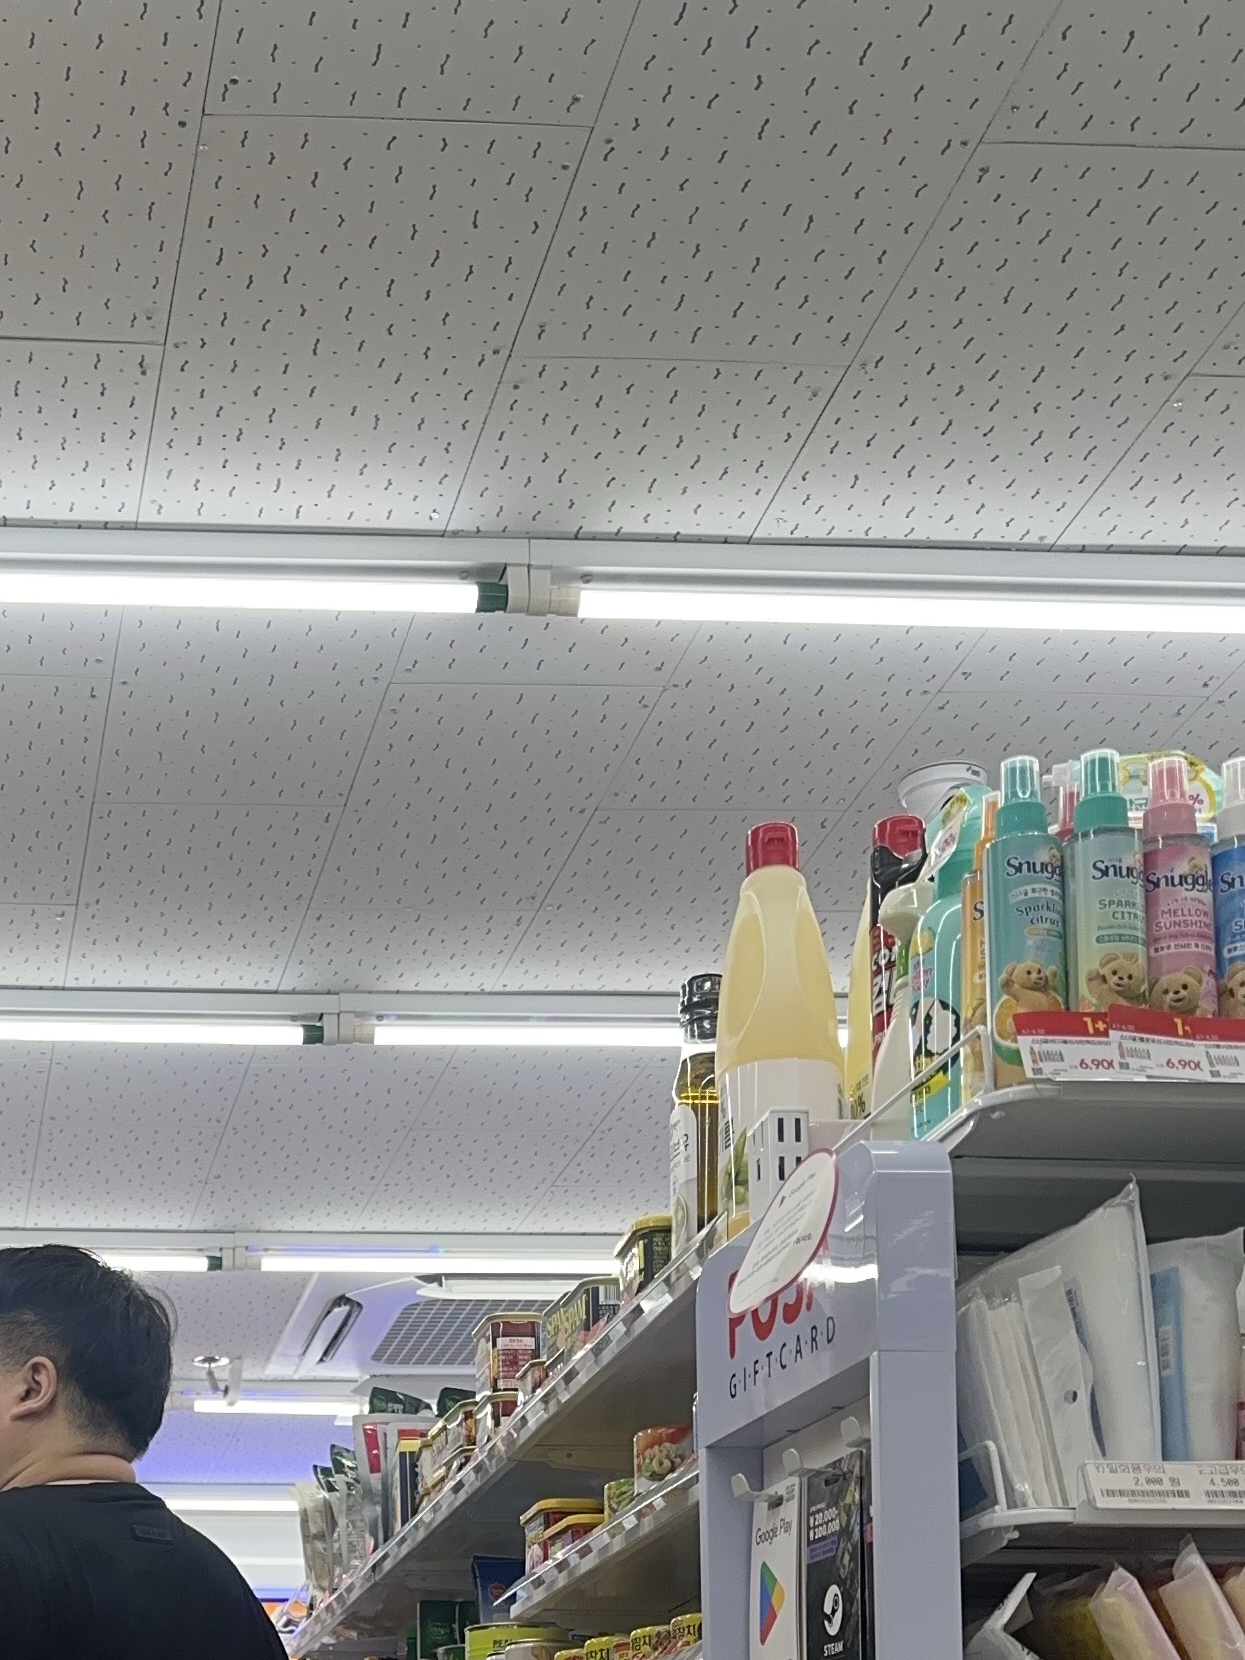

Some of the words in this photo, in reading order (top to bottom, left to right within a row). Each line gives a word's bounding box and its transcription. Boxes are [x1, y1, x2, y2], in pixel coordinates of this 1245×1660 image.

[1082, 1016, 1108, 1035] 1+
[755, 1520, 779, 1546] Google
[778, 1516, 794, 1538] Play
[823, 1640, 844, 1657] STEAM
